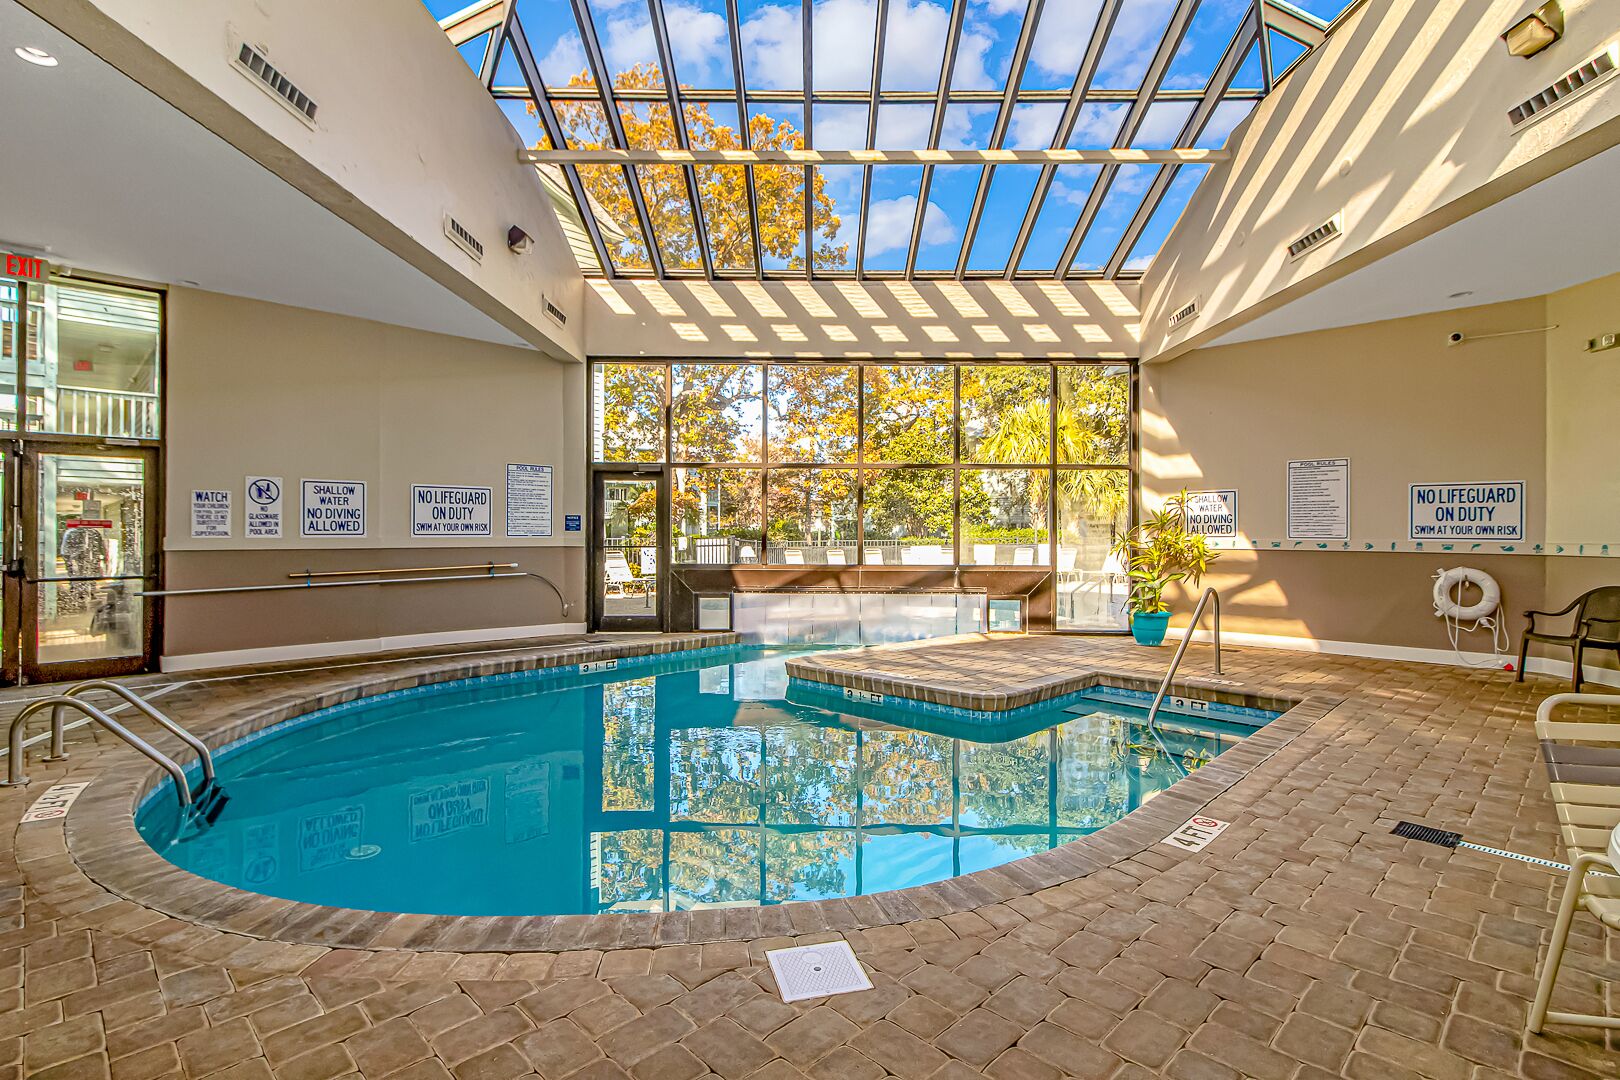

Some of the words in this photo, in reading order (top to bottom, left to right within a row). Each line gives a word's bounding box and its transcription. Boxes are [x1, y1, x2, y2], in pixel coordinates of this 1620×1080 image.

[6, 253, 42, 278] EXIT
[313, 485, 355, 495] SHALLOW
[195, 491, 228, 502] WATCH
[418, 490, 432, 504] NO
[434, 490, 487, 505] LIFEGUARD
[1195, 495, 1228, 503] SHALLOW
[1417, 489, 1436, 504] NO
[1439, 488, 1516, 504] LIFEGUARD
[319, 497, 349, 506] WATER
[432, 506, 446, 520] ON
[449, 507, 474, 520] DUTY
[1200, 504, 1222, 512] WATER
[307, 508, 322, 519] NO
[326, 508, 360, 520] DIVING
[1190, 515, 1202, 524] NO
[1204, 514, 1233, 524] DIVING
[1436, 506, 1454, 522] ON
[1458, 506, 1496, 522] DUTY
[308, 520, 360, 532] ALLOWED
[416, 523, 432, 532] SWIM
[433, 523, 441, 532] AT
[442, 523, 460, 532] YOUR
[460, 523, 474, 532] OWN
[475, 523, 488, 532] RISK
[1190, 525, 1232, 534] ALLOWED
[1414, 525, 1436, 534] SWIM
[1437, 525, 1449, 534] AT
[1450, 525, 1473, 535] YOUR
[1475, 525, 1495, 535] OWN
[1497, 526, 1518, 535] RISK
[1180, 825, 1213, 840] FT
[1173, 836, 1200, 846] 4
